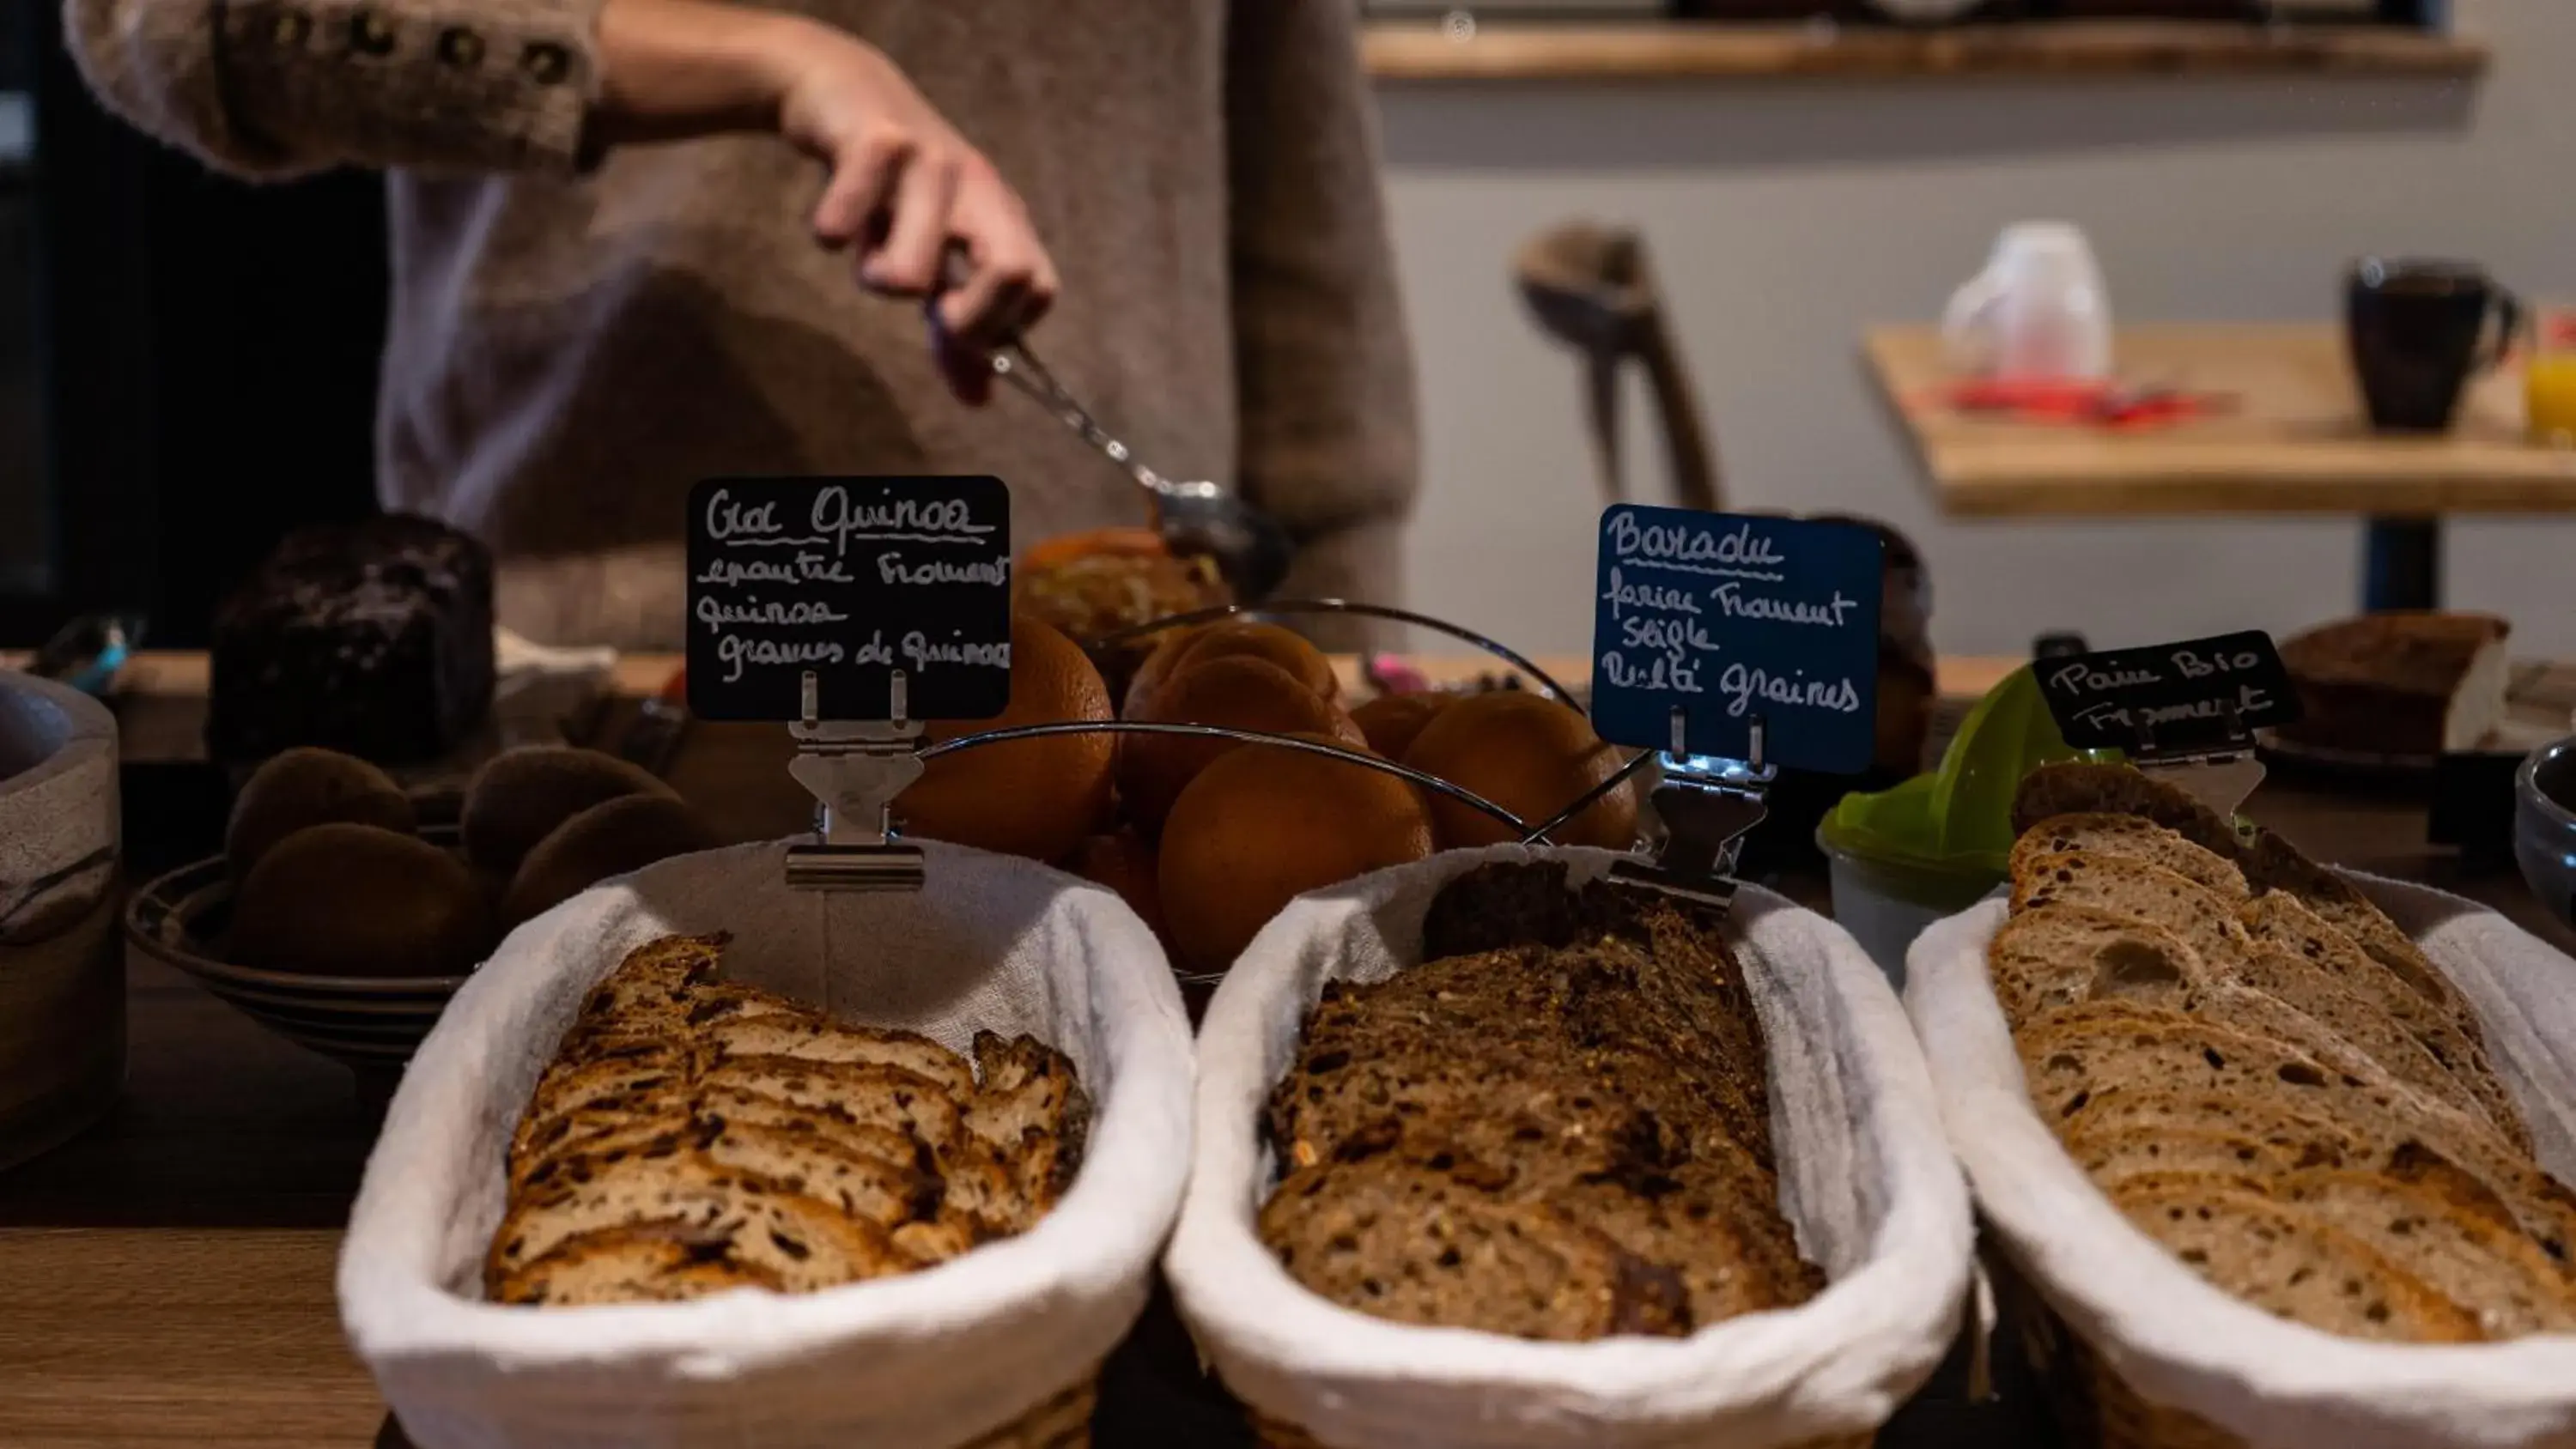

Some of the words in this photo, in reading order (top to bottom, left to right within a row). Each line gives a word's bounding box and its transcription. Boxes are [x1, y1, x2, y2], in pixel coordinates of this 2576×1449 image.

[811, 486, 996, 556] Quinoa
[696, 596, 848, 634] Quinoa
[1602, 566, 1702, 620] farine
[855, 629, 893, 665] de
